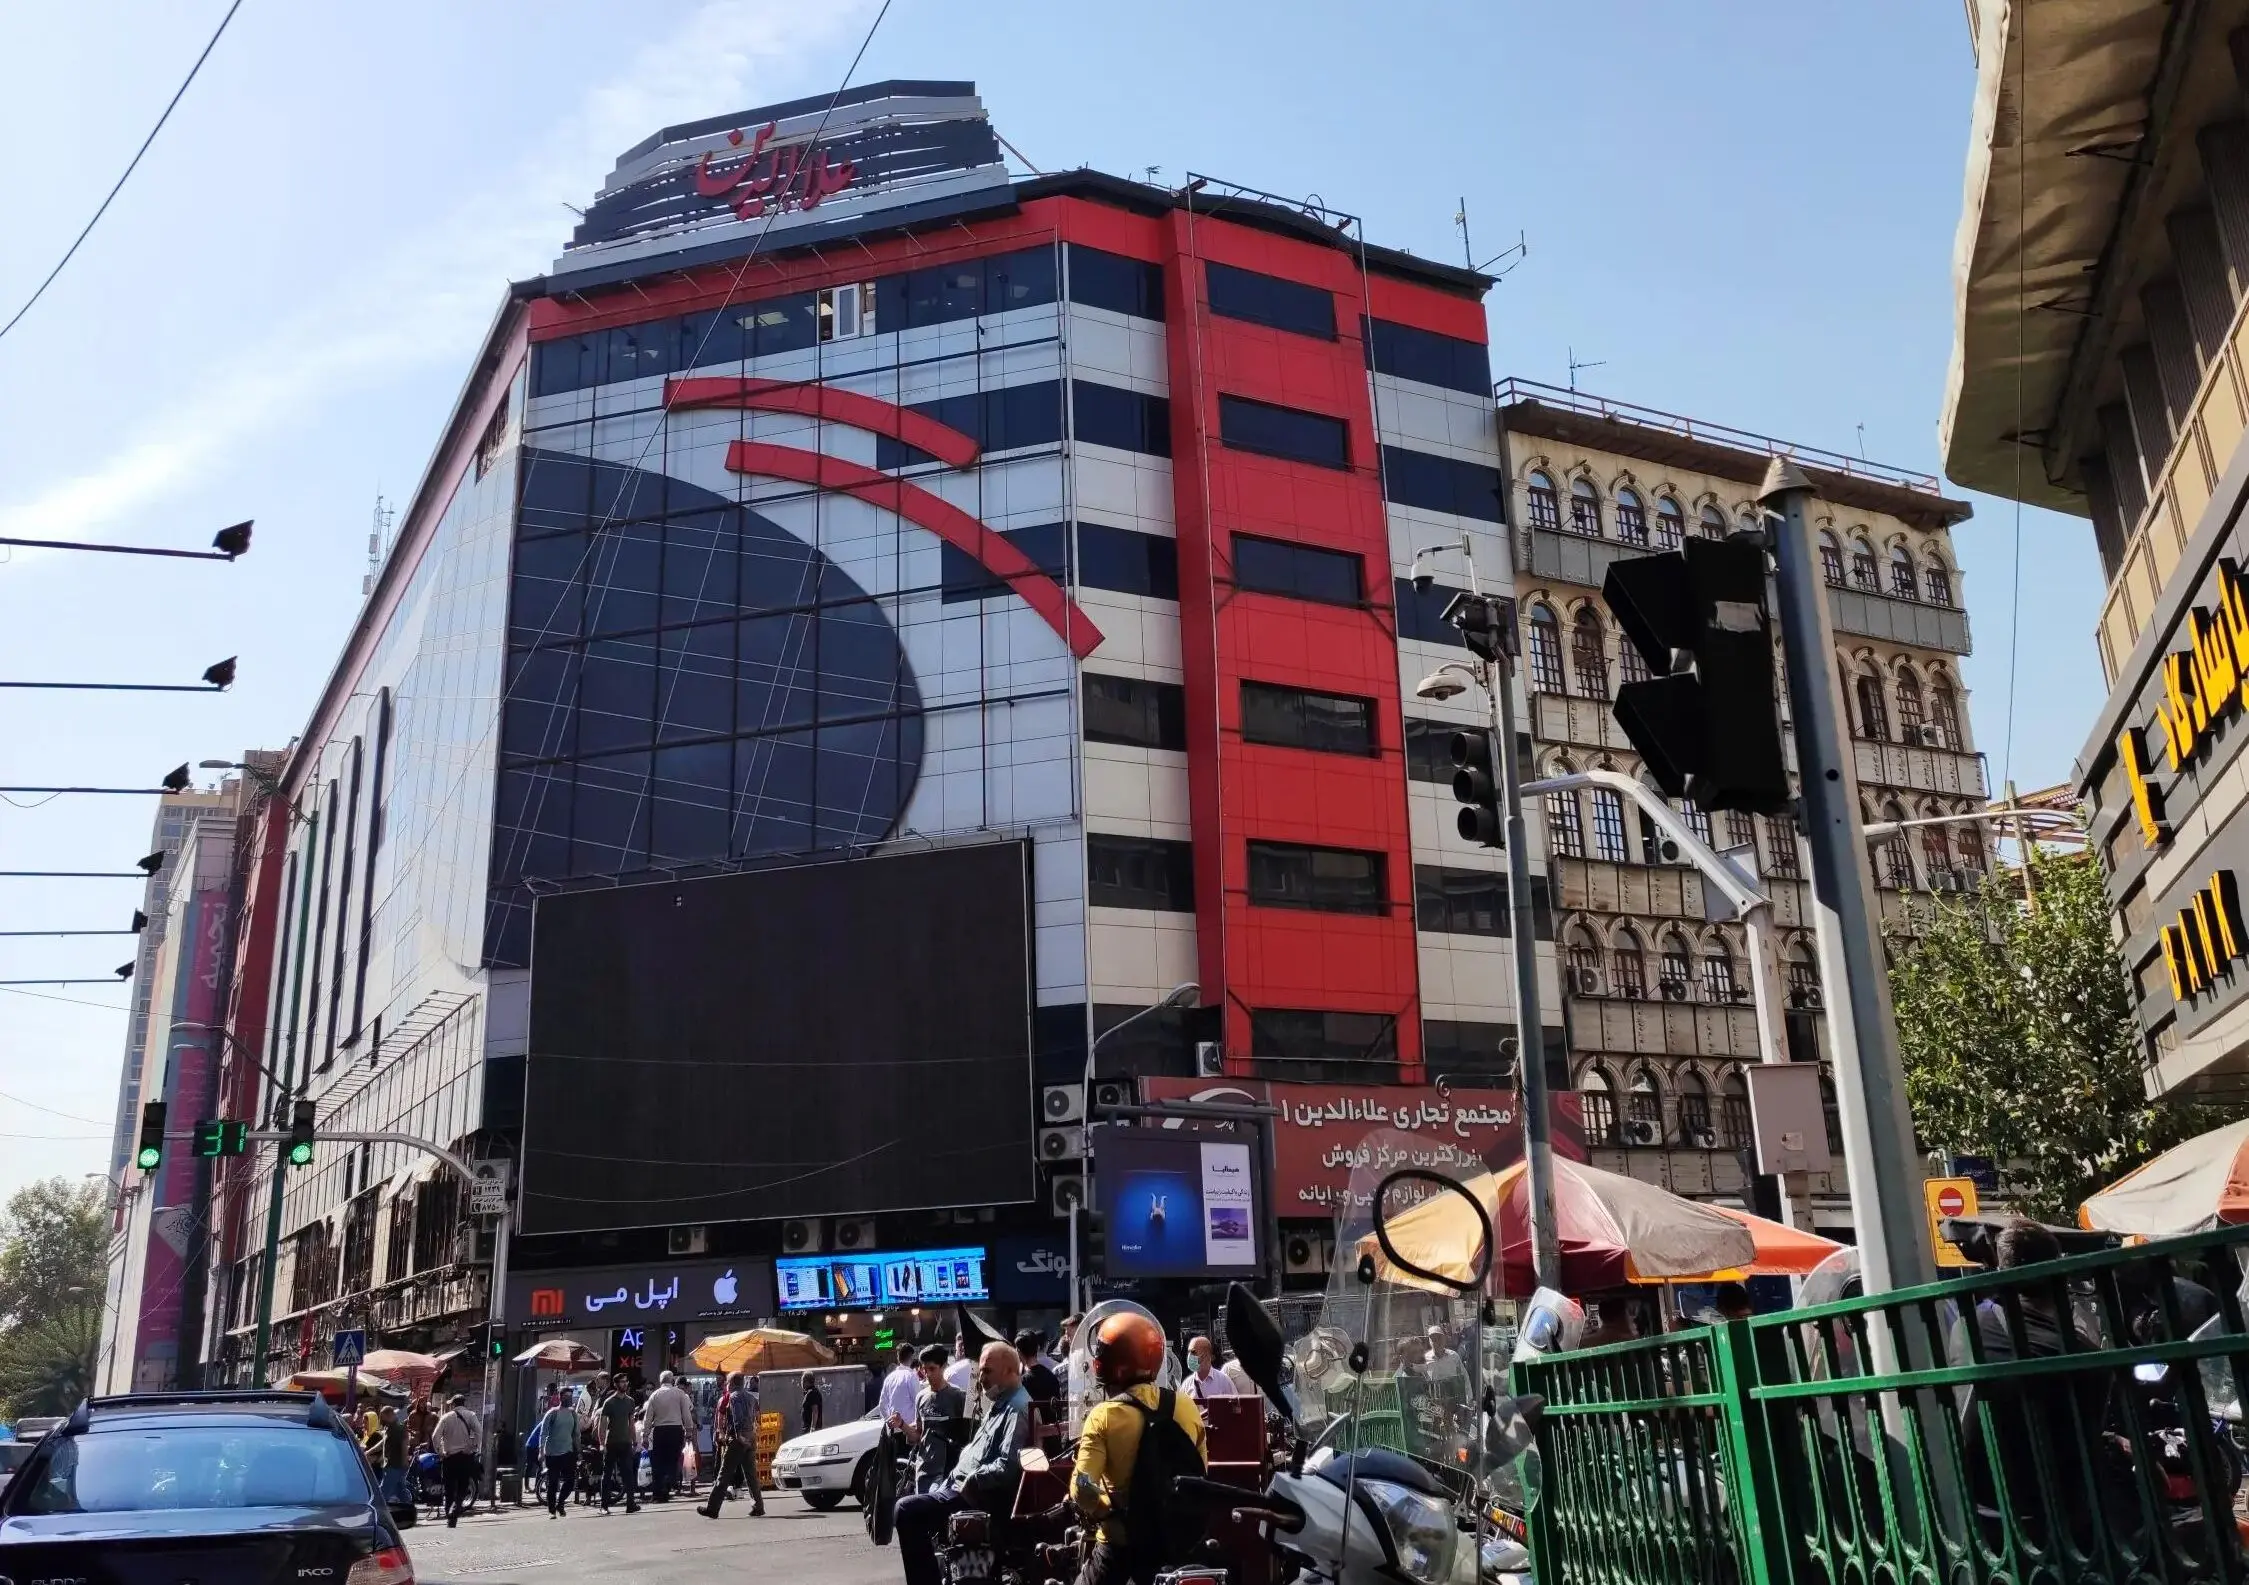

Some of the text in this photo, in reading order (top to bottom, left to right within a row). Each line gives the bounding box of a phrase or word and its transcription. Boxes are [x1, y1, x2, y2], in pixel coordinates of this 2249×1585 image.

[2160, 869, 2245, 1001] BANK
[1393, 1101, 1450, 1130] تجاری
[1455, 1104, 1512, 1137] مجتمع
[1322, 1143, 1371, 1168] فروش
[1374, 1144, 1407, 1169] مرکز
[586, 1276, 679, 1312] اپل می
[620, 1328, 677, 1351] Ape
[298, 1568, 334, 1577] IKCO
